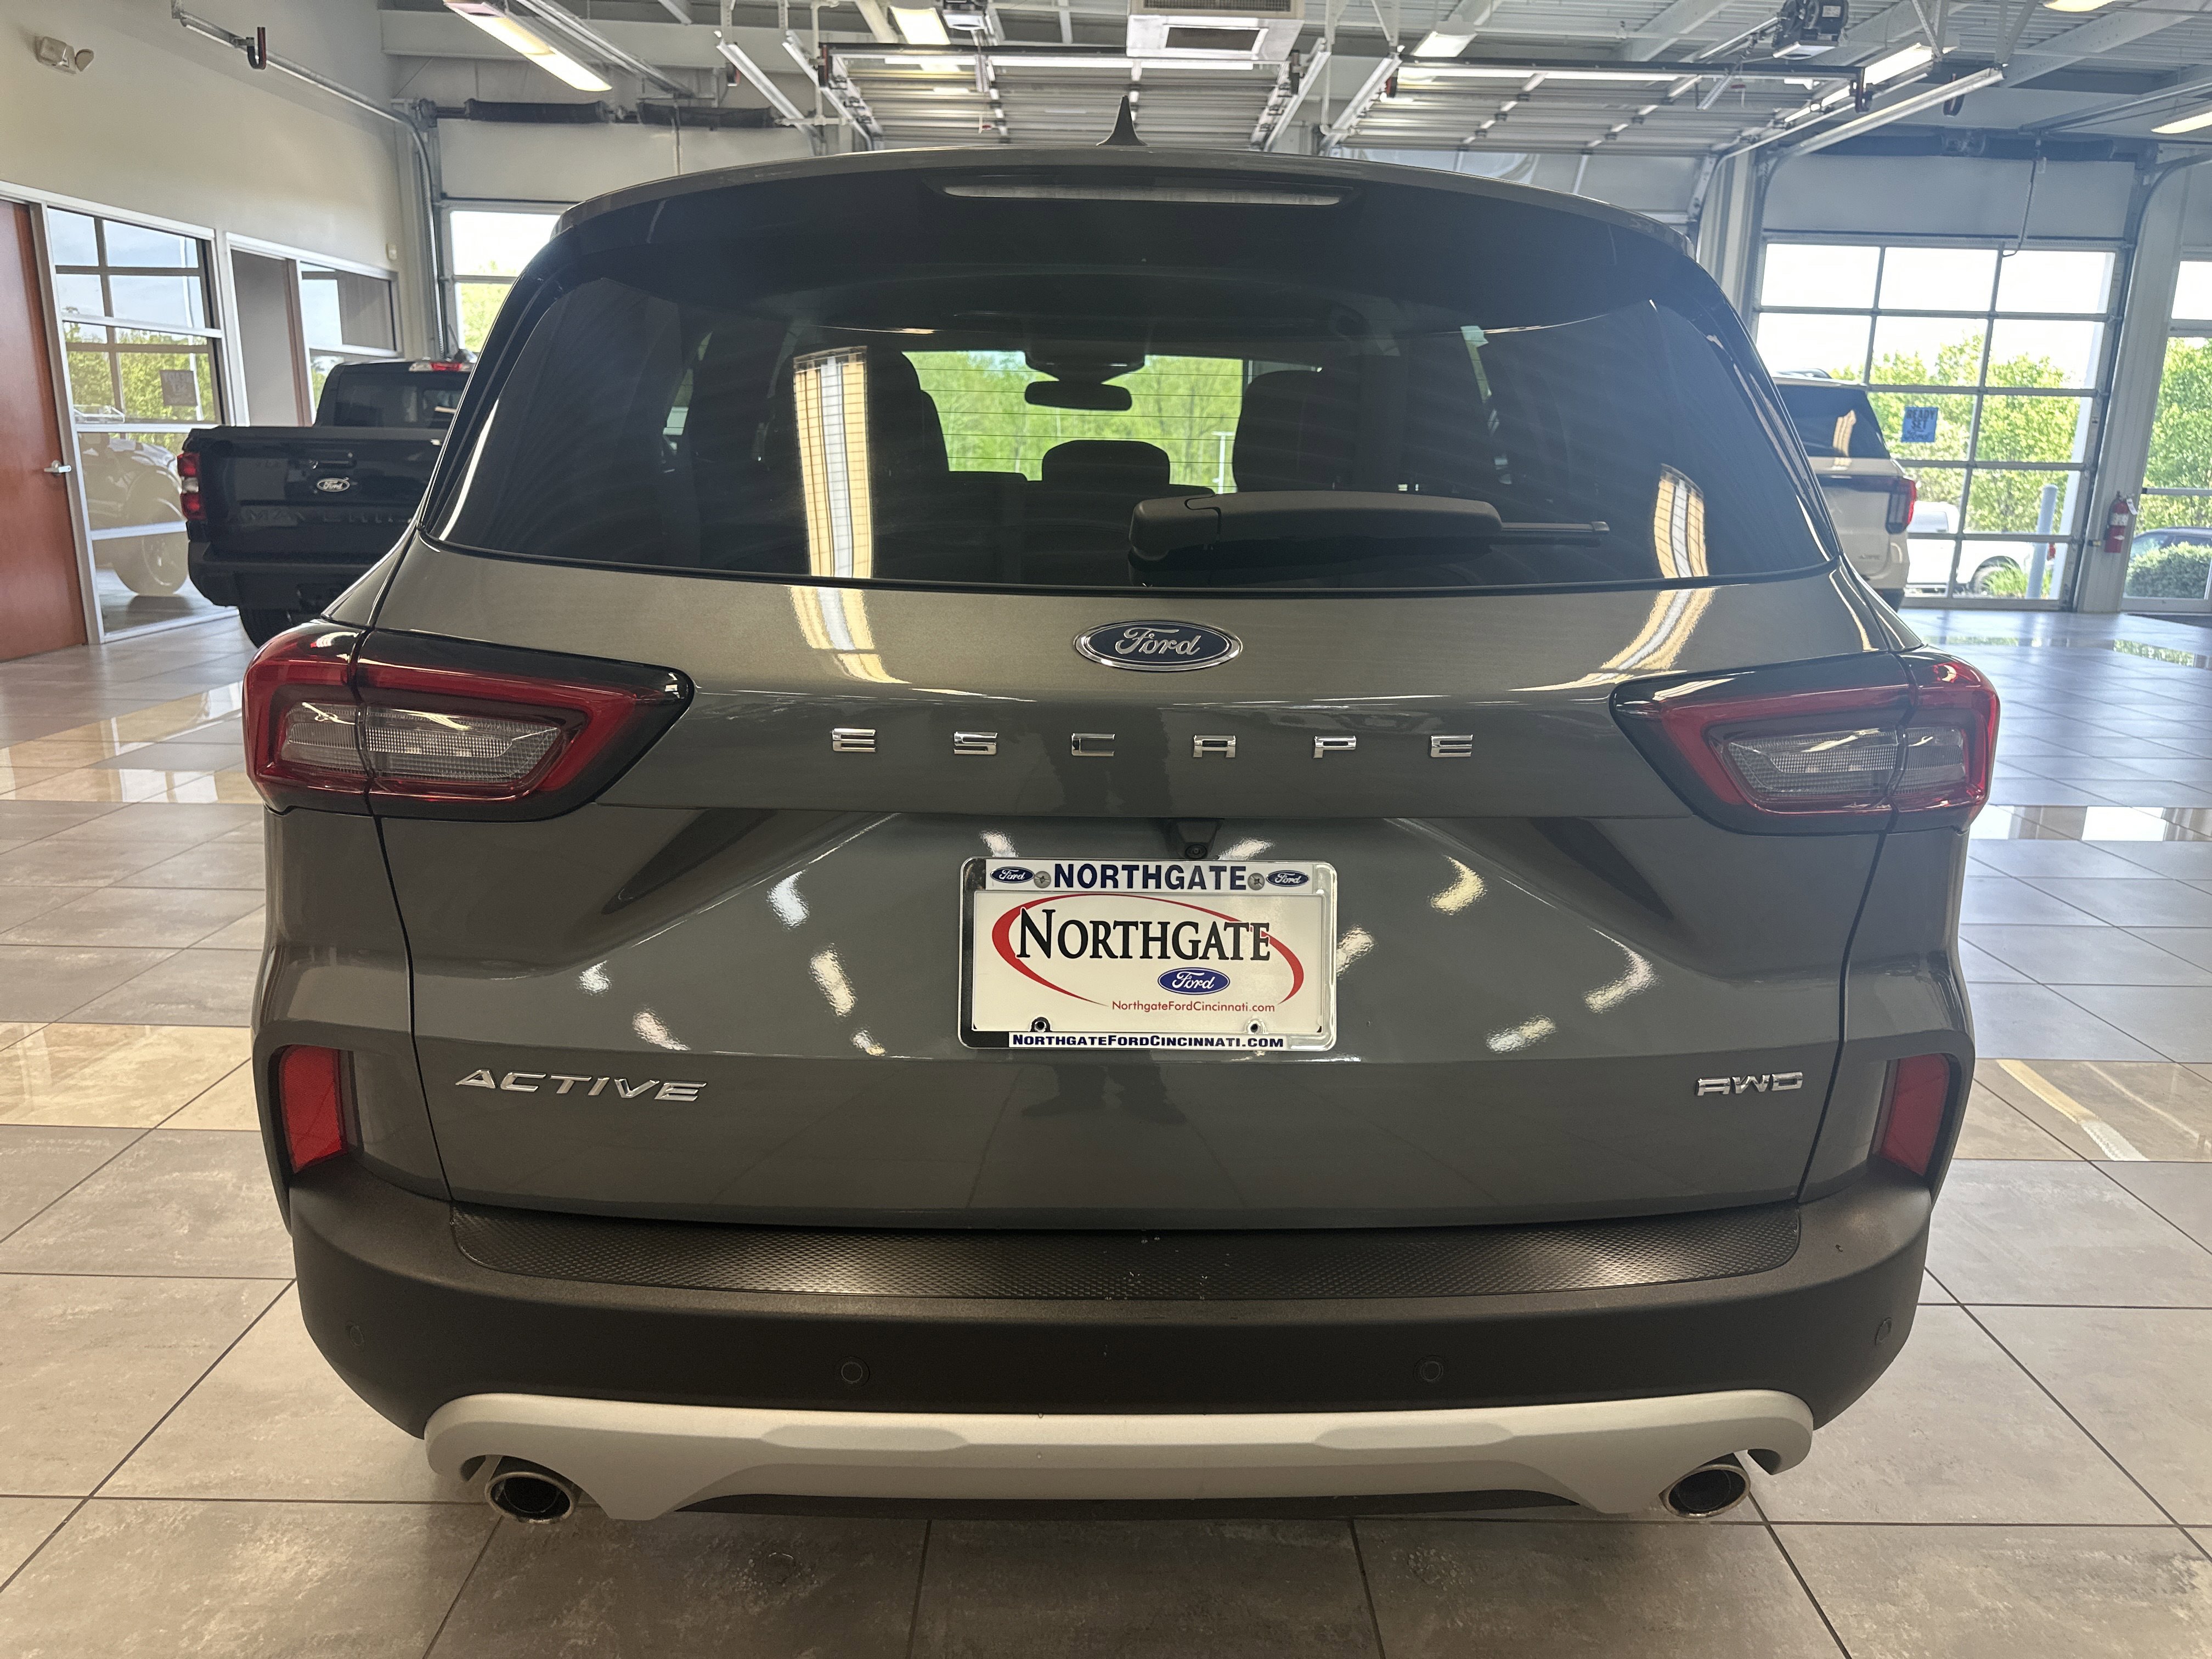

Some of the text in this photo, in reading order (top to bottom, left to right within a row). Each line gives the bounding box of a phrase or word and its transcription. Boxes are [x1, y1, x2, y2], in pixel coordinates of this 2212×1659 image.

[1906, 409, 1936, 420] READY
[1115, 627, 1201, 655] Ford
[831, 728, 1475, 759] ESCAPE
[998, 863, 1302, 890] Ford NORTHGATE Ford
[1017, 907, 1271, 961] NORTHGATE
[1171, 970, 1216, 990] Ford
[1112, 1000, 1276, 1013] NorthgateFordCincinnati.com
[1013, 1034, 1284, 1048] NORTHGATEFORDCINCINNATI.COM
[455, 1068, 707, 1102] ACTIVE
[1697, 1071, 1803, 1096] AWD
